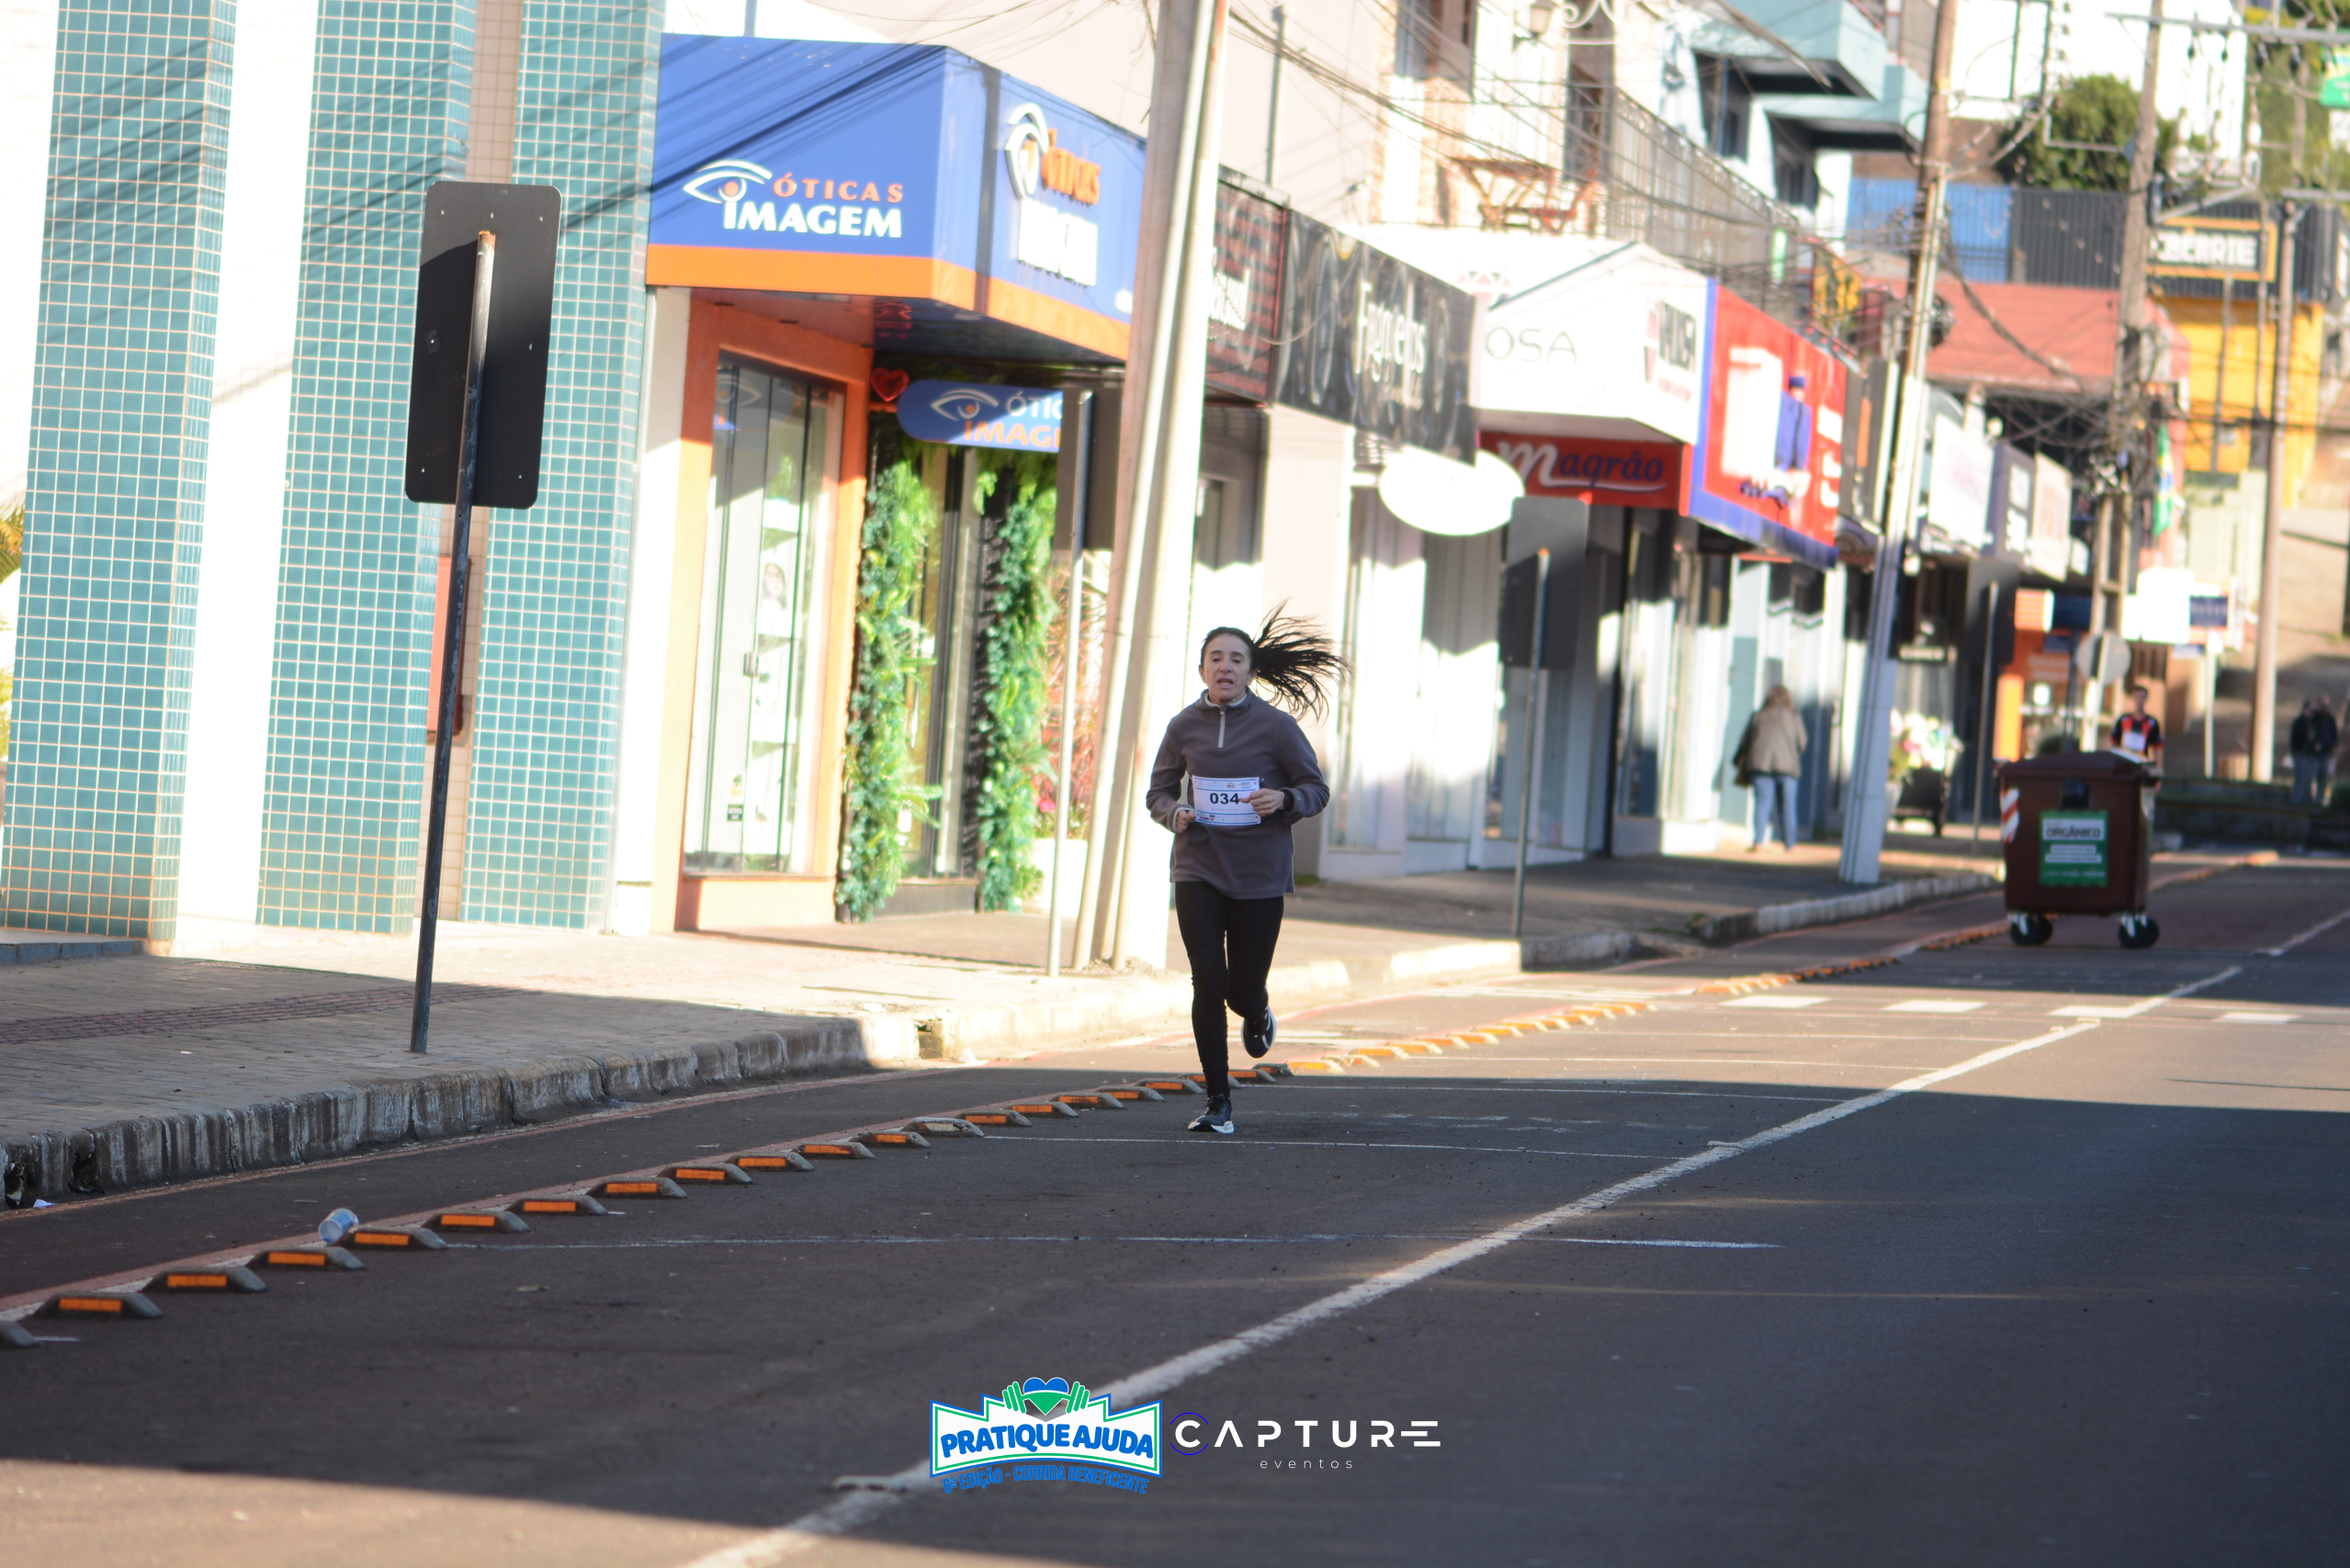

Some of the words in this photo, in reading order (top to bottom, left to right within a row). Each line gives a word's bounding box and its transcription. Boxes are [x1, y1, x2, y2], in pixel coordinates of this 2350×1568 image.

[774, 173, 903, 203] ÓTICAS
[724, 201, 902, 238] IMAGEM
[1209, 793, 1239, 805] 034
[2047, 826, 2101, 838] ORGÂNICO
